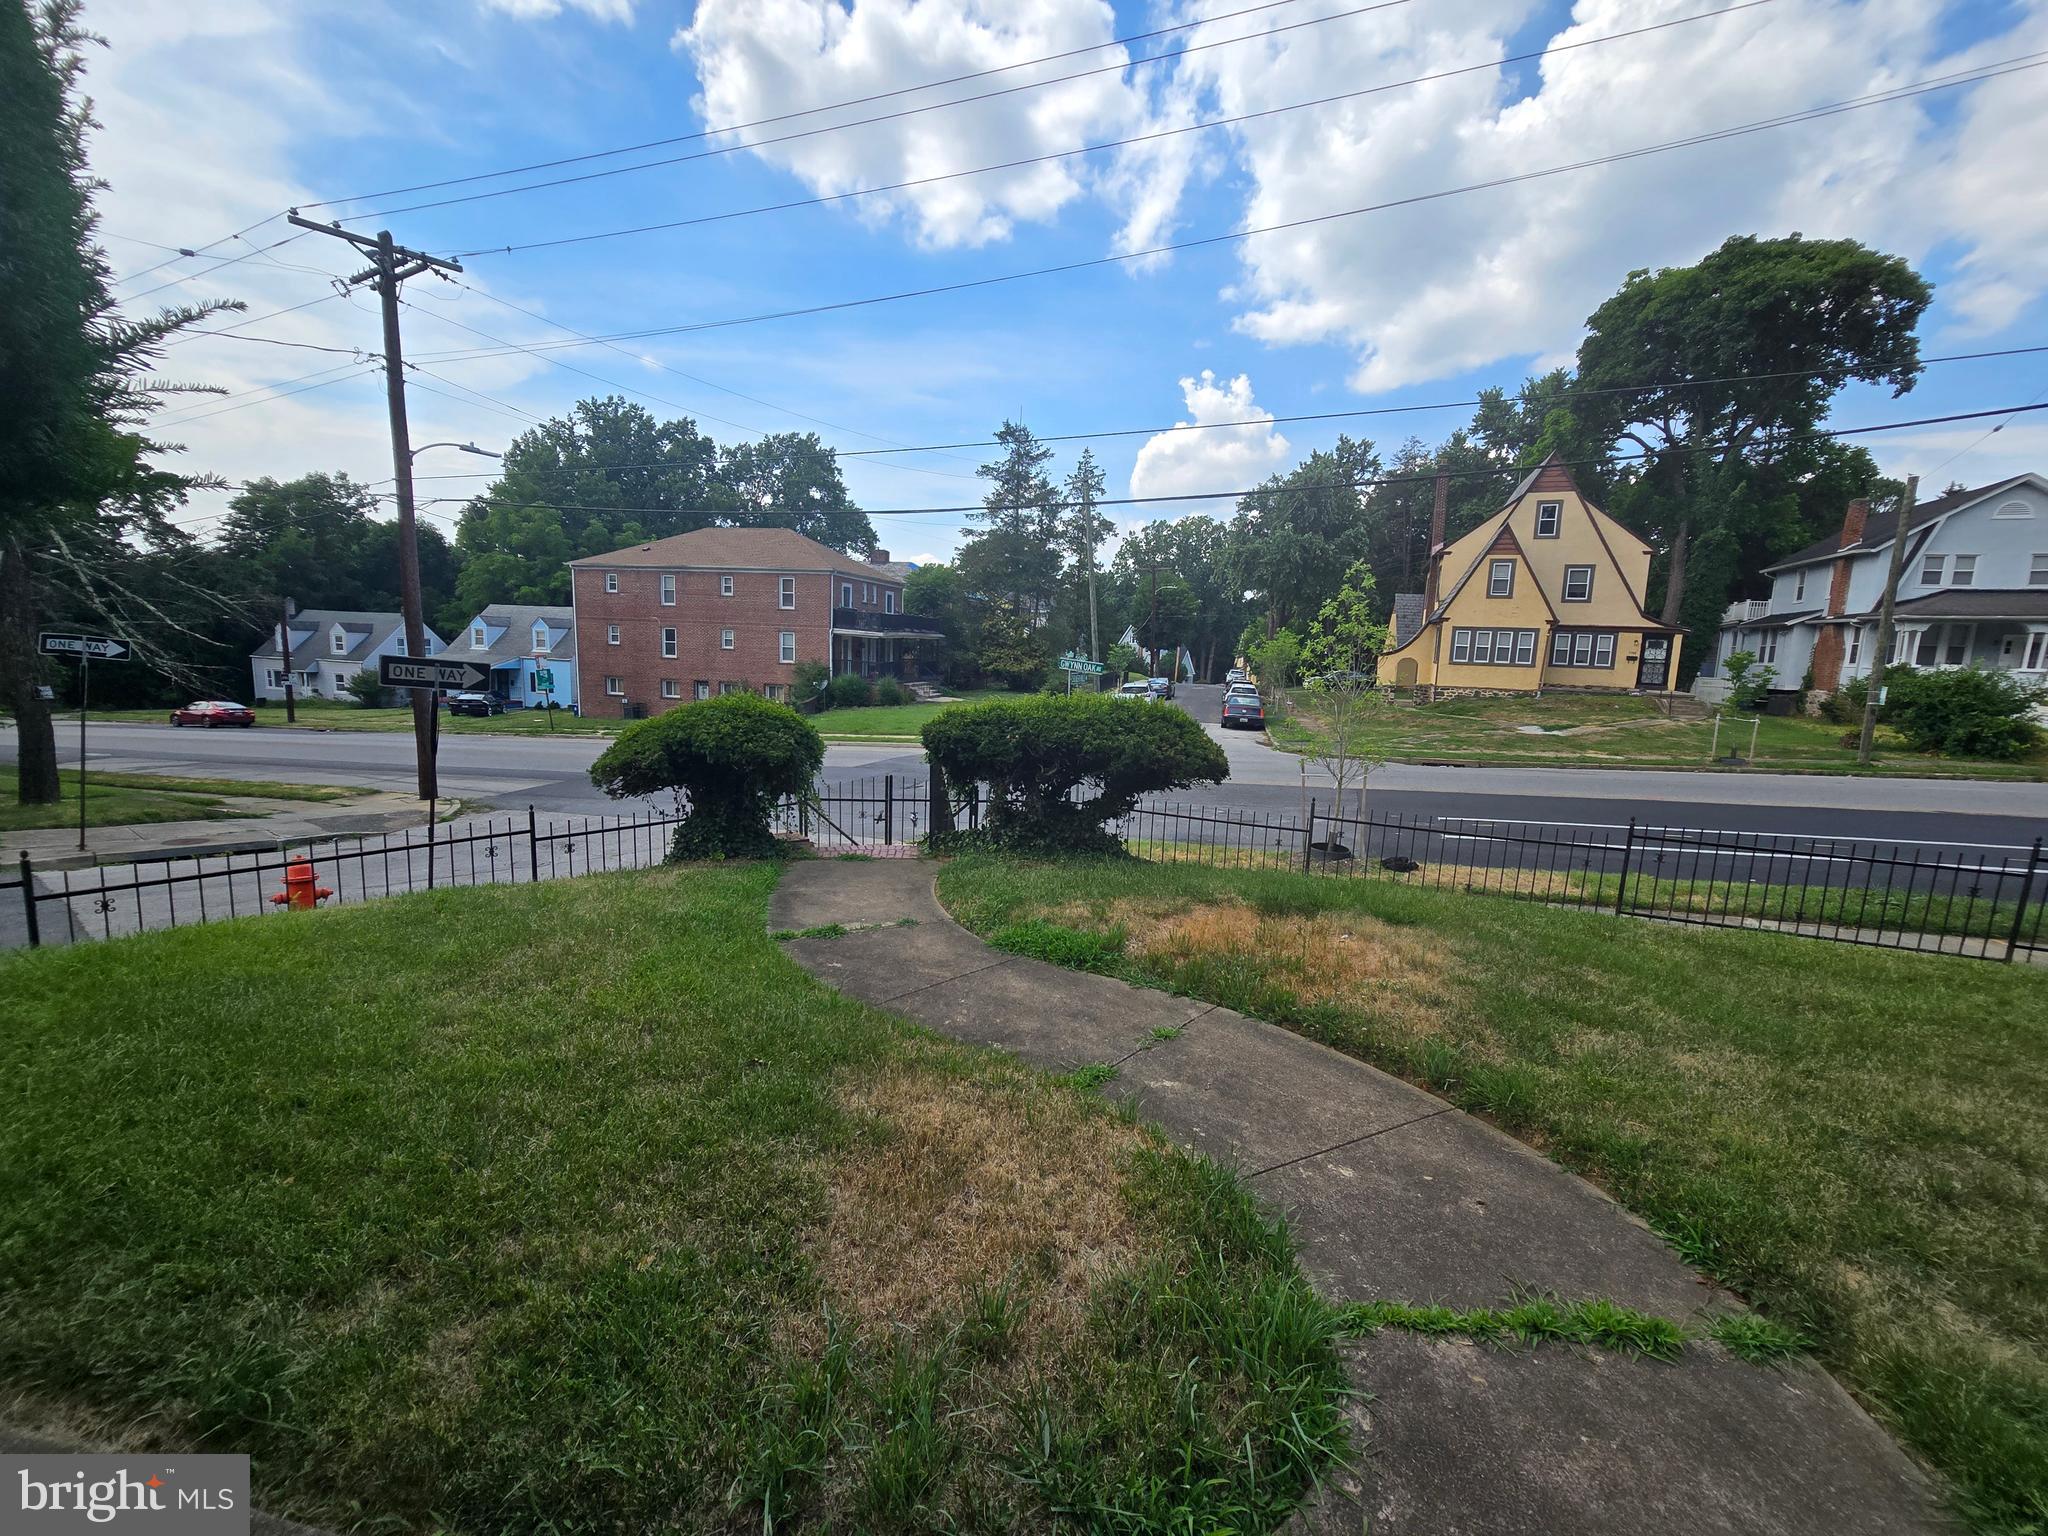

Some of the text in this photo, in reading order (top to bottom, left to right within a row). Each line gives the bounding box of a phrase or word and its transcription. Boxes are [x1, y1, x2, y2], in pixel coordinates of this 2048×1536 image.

[49, 639, 75, 649] ONE
[393, 665, 426, 679] ONE
[1060, 659, 1083, 670] GWYNN
[1083, 663, 1096, 672] OAK
